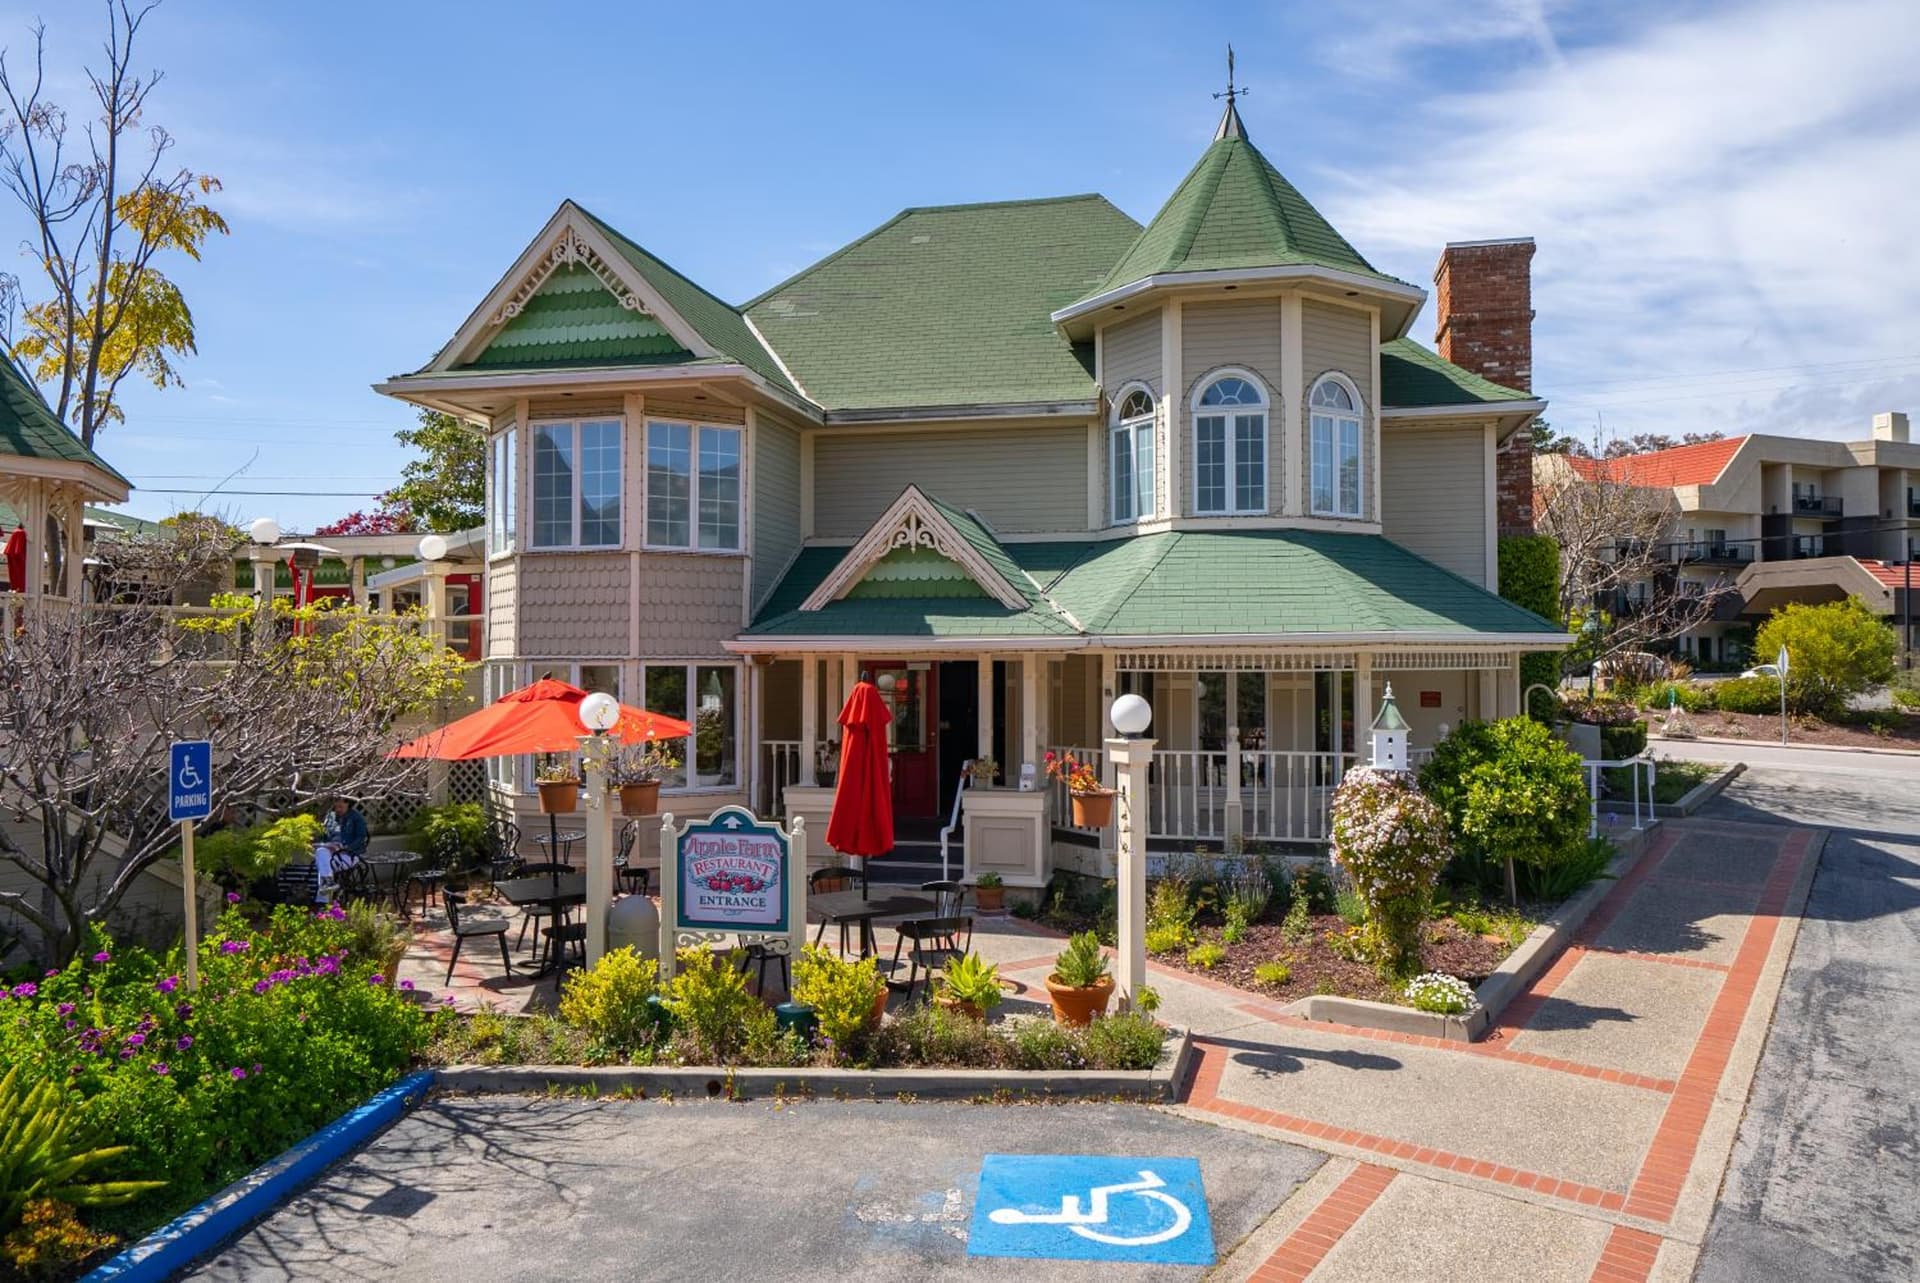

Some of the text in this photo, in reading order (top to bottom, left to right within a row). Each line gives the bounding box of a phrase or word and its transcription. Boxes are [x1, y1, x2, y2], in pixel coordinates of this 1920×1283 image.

[174, 792, 207, 808] PARKING
[682, 837, 783, 857] Apple Farm
[693, 857, 772, 876] RESTAURANT
[699, 895, 767, 907] ENTRANCE
